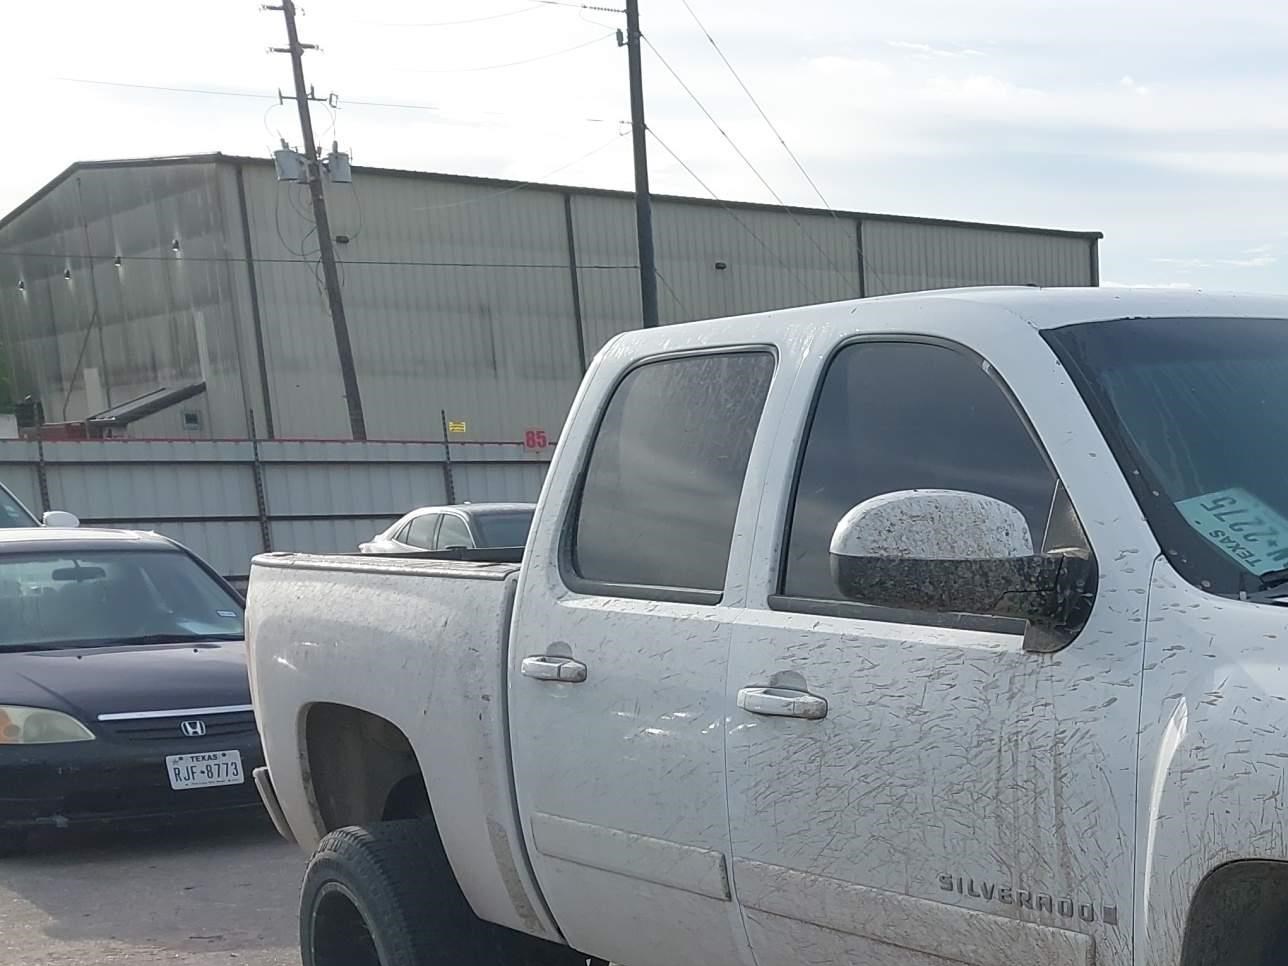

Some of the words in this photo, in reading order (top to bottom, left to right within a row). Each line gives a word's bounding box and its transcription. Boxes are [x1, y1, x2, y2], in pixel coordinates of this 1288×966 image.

[525, 431, 547, 448] 85
[1209, 529, 1262, 568] TEXAS
[190, 754, 218, 762] TEXAS
[938, 875, 1094, 922] SILVERADO
